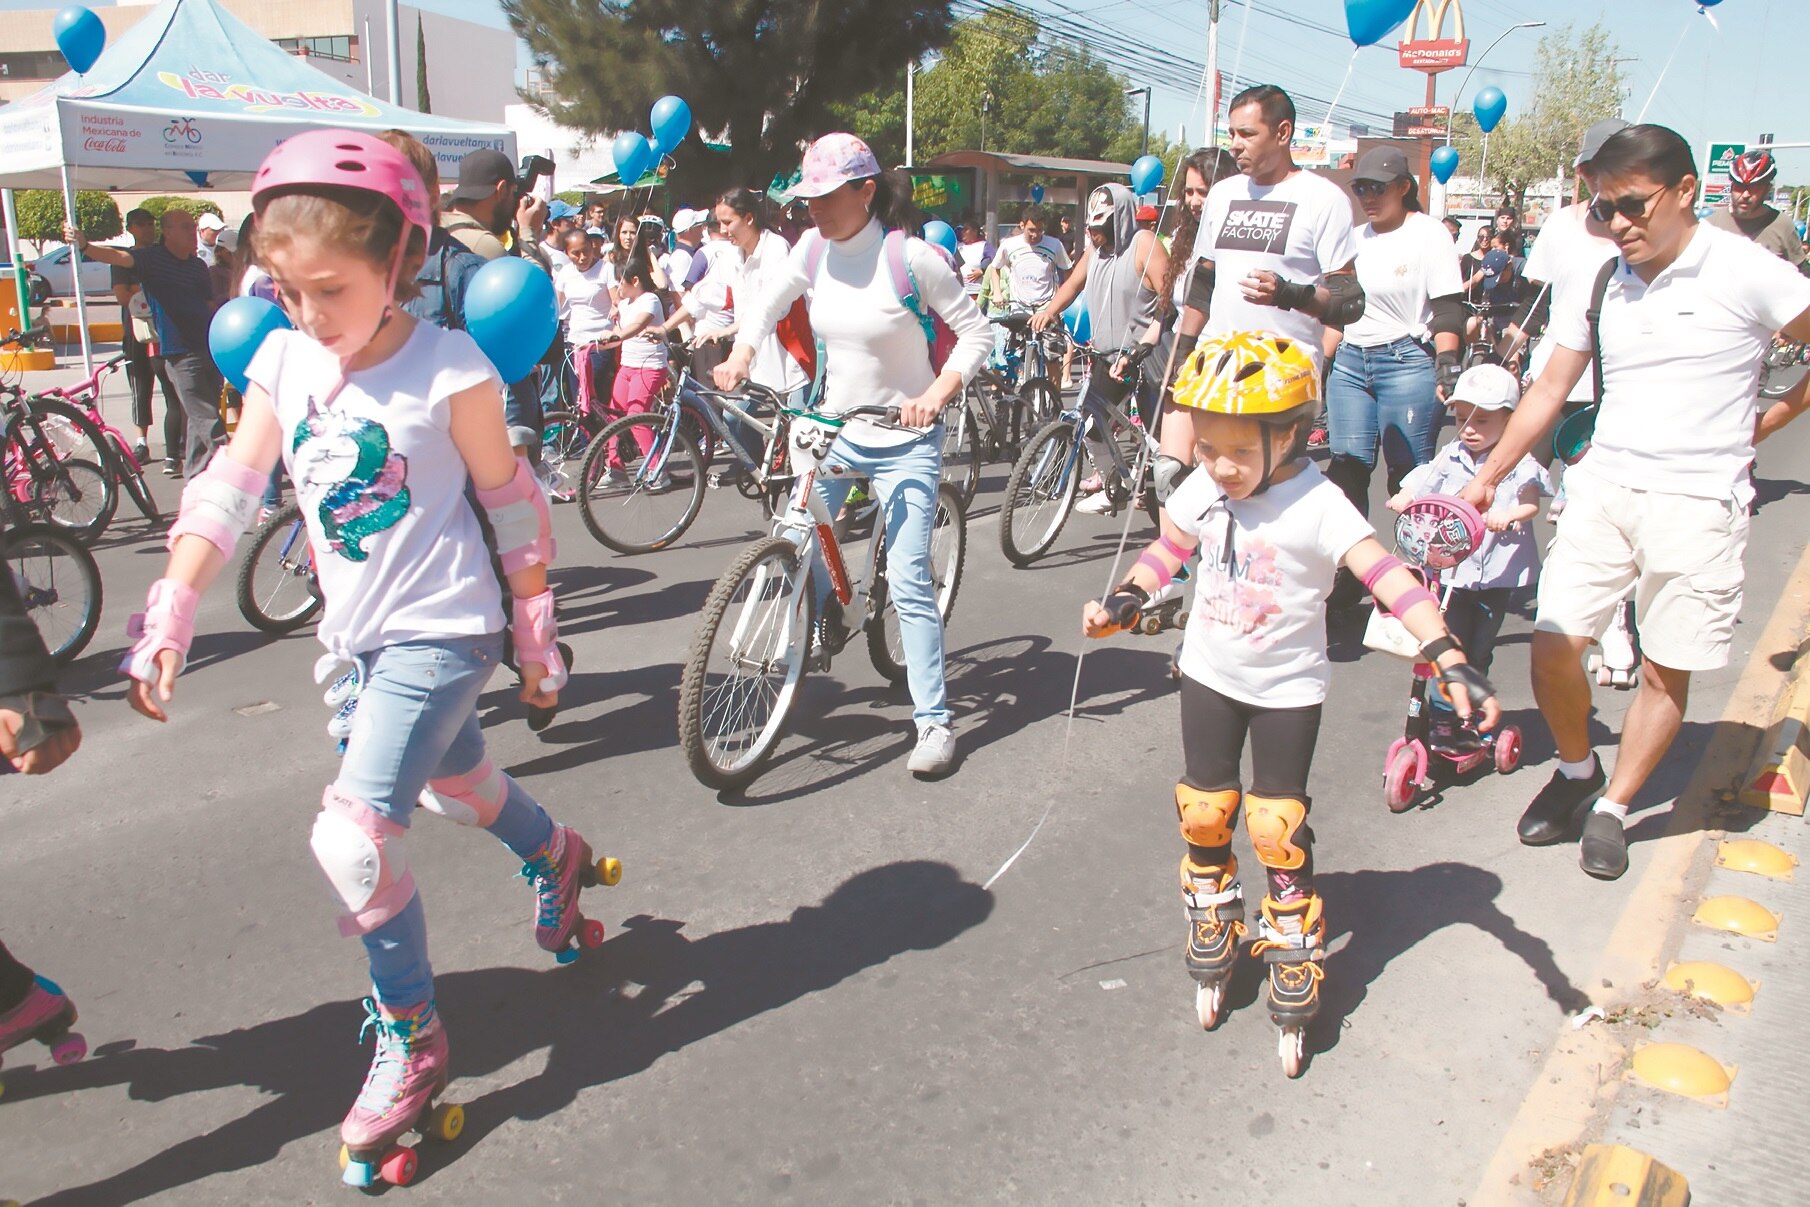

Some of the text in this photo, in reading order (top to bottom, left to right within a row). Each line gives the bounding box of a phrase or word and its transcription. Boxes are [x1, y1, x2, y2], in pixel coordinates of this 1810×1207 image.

[1402, 49, 1462, 58] McDonald's
[189, 65, 231, 83] dar
[182, 78, 364, 111] la vuelta
[81, 115, 124, 126] Industria
[82, 126, 141, 137] Mexicana de
[1226, 210, 1289, 229] SKATE
[1221, 226, 1282, 240] FACTORY
